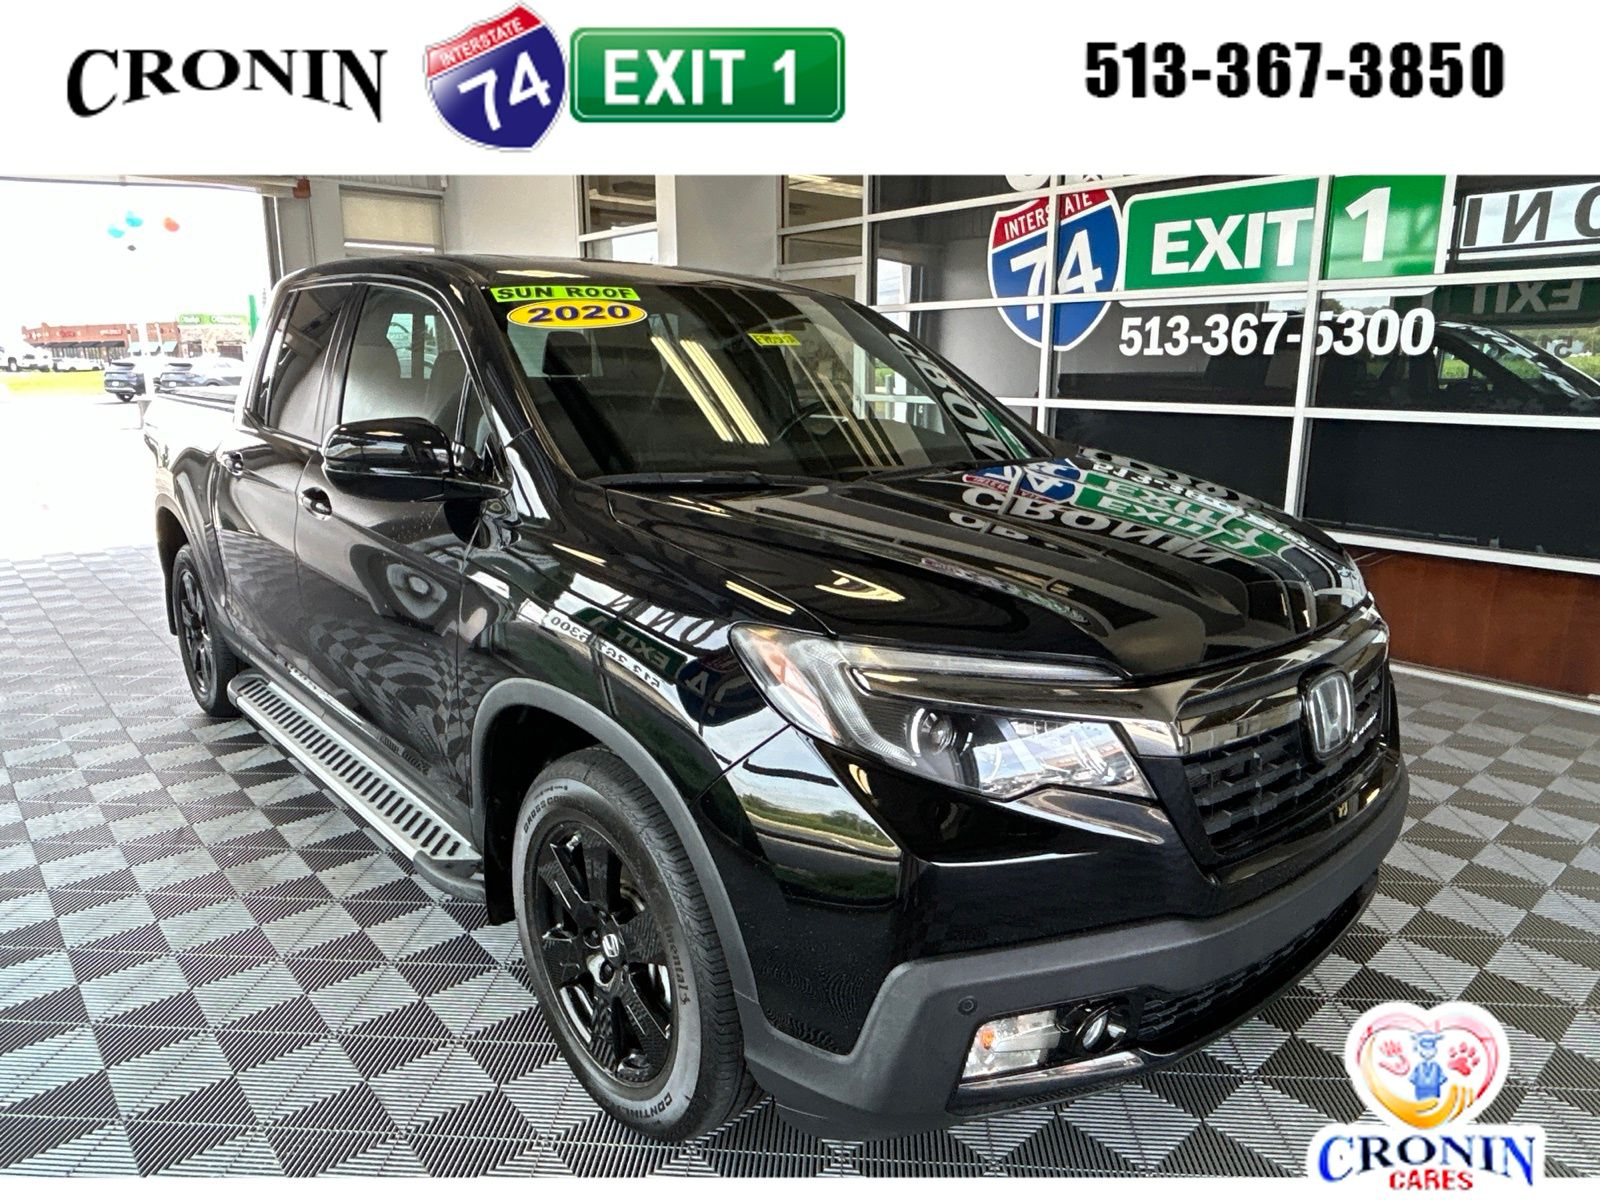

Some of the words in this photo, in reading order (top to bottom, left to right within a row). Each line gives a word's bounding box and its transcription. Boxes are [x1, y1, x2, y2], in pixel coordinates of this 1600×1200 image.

[1151, 206, 1315, 275] EXIT
[1344, 186, 1391, 263] 1
[497, 286, 553, 300] SUN
[565, 286, 634, 300] ROOF
[1009, 229, 1104, 321] 74
[527, 304, 632, 324] 2020
[1119, 307, 1436, 357] 513-367-5300
